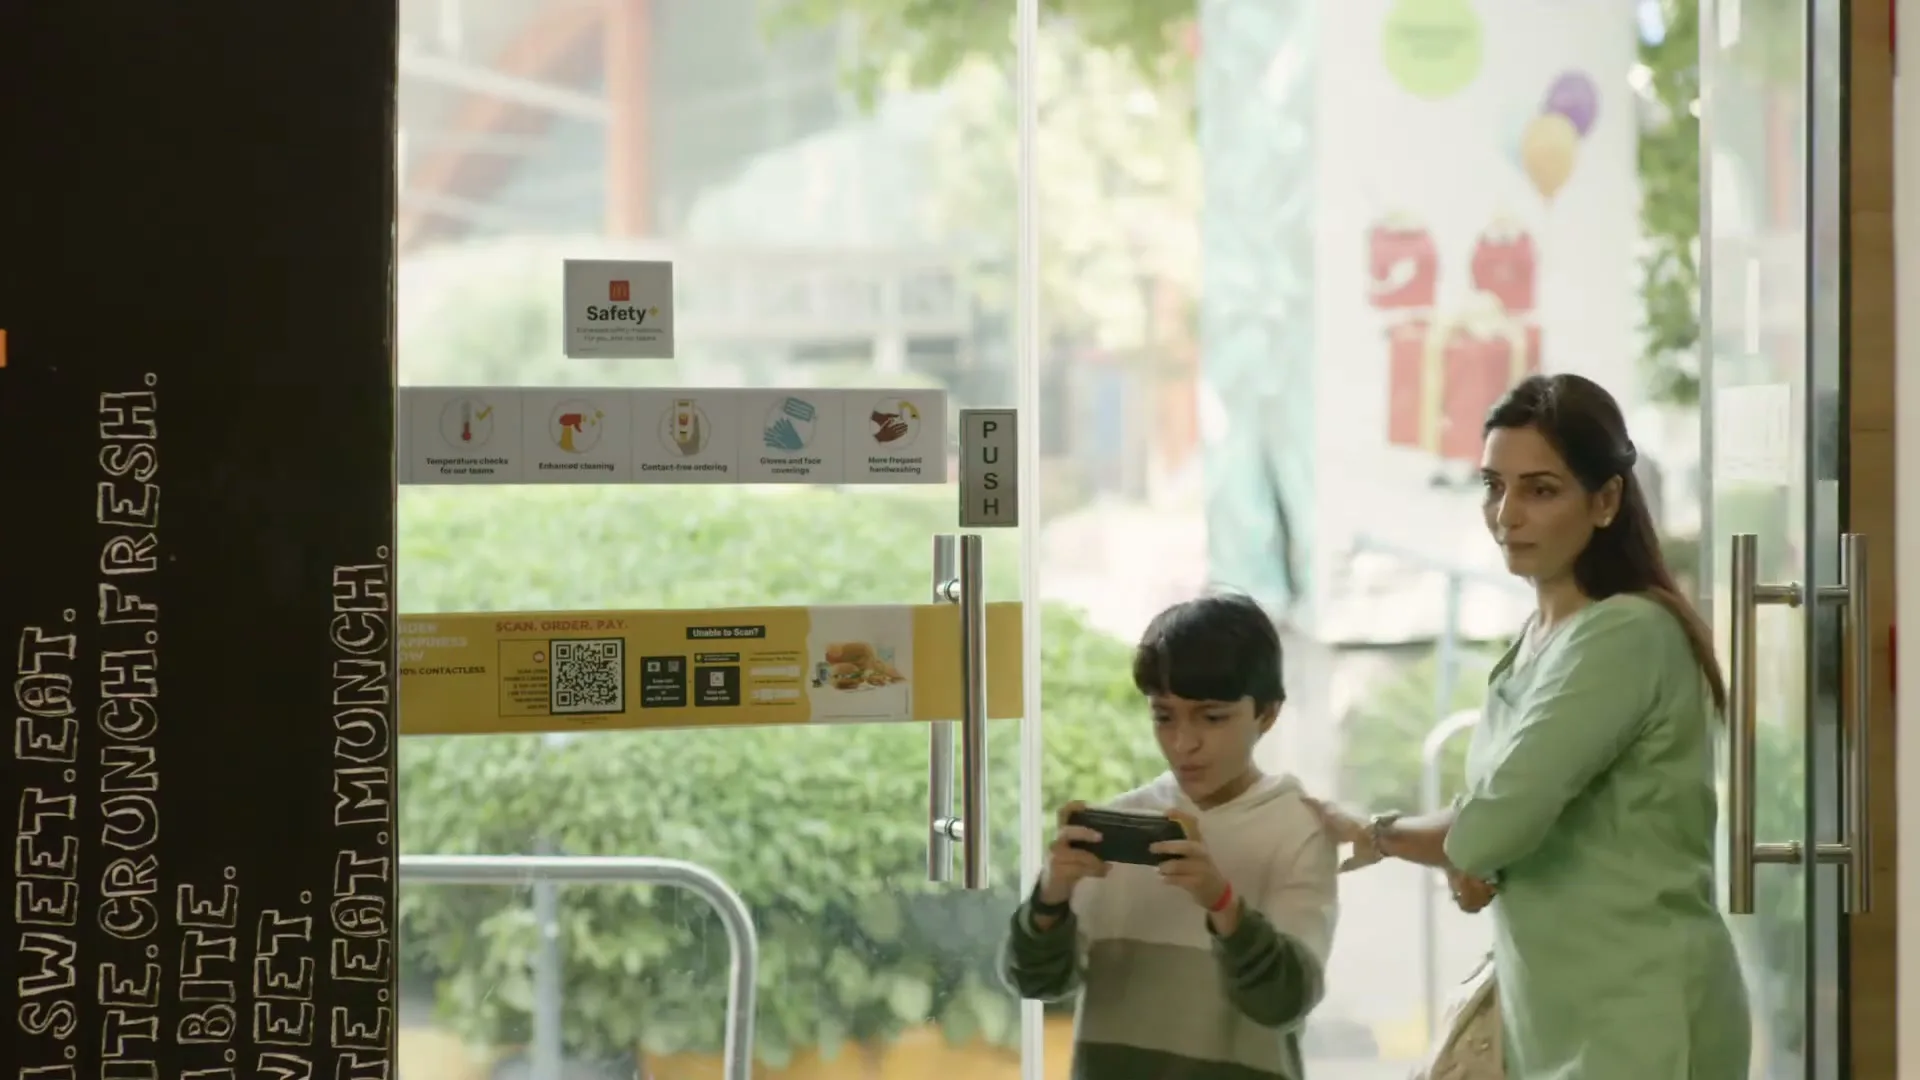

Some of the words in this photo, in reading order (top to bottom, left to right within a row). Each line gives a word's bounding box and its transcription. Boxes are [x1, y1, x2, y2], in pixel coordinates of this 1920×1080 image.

[426, 457, 477, 466] Temperature
[479, 457, 508, 465] checks
[469, 467, 494, 475] teams
[538, 462, 579, 470] Enhanced
[580, 463, 615, 472] cleaning
[693, 463, 728, 473] ordering
[869, 466, 921, 475] handwashing
[983, 421, 998, 515] PUSH
[495, 620, 538, 633] SCAN.
[541, 620, 593, 632] ORDER.
[597, 619, 628, 630] PAY.
[692, 628, 722, 637] Unable
[723, 628, 732, 636] to
[733, 627, 759, 636] Scan?
[419, 666, 486, 675] CONTACTLESS
